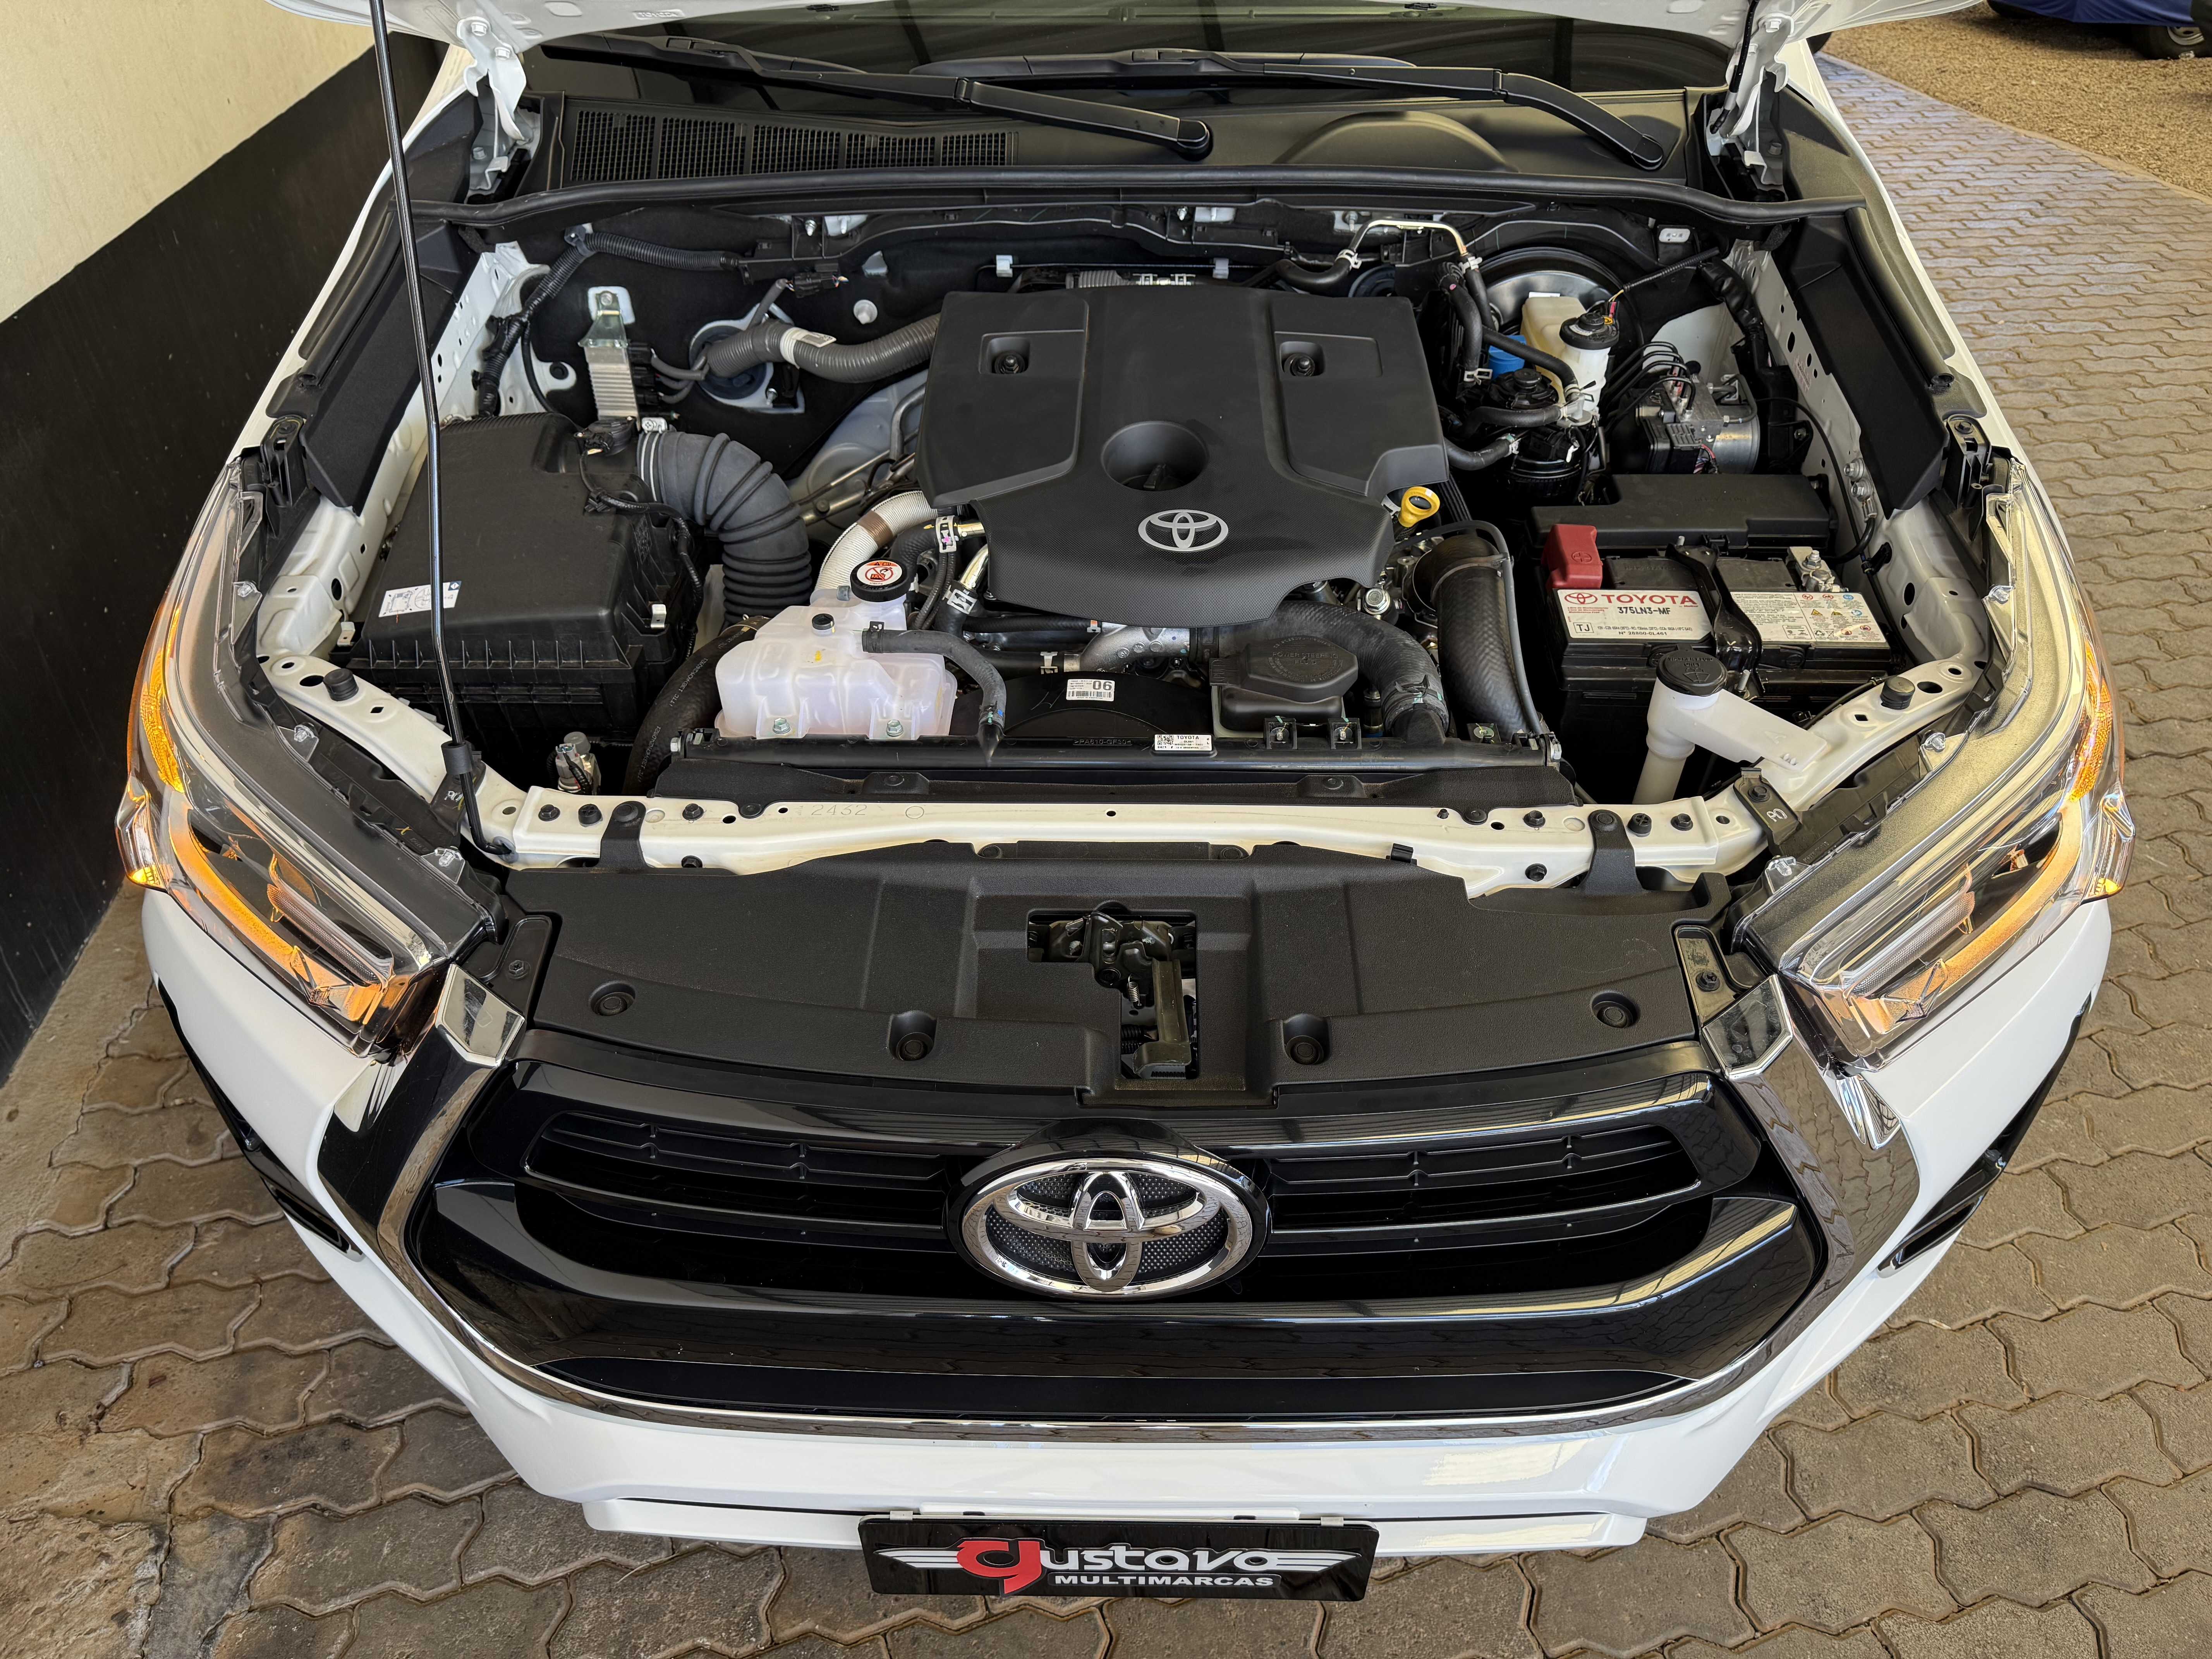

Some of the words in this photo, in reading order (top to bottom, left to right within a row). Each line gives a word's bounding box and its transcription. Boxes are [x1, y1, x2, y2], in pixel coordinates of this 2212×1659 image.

[1601, 594, 1697, 605] TOYOTA
[1617, 606, 1670, 615] 375LN3-MF
[1092, 680, 1112, 690] 06
[1055, 1575, 1274, 1586] MULTIMARCAS
